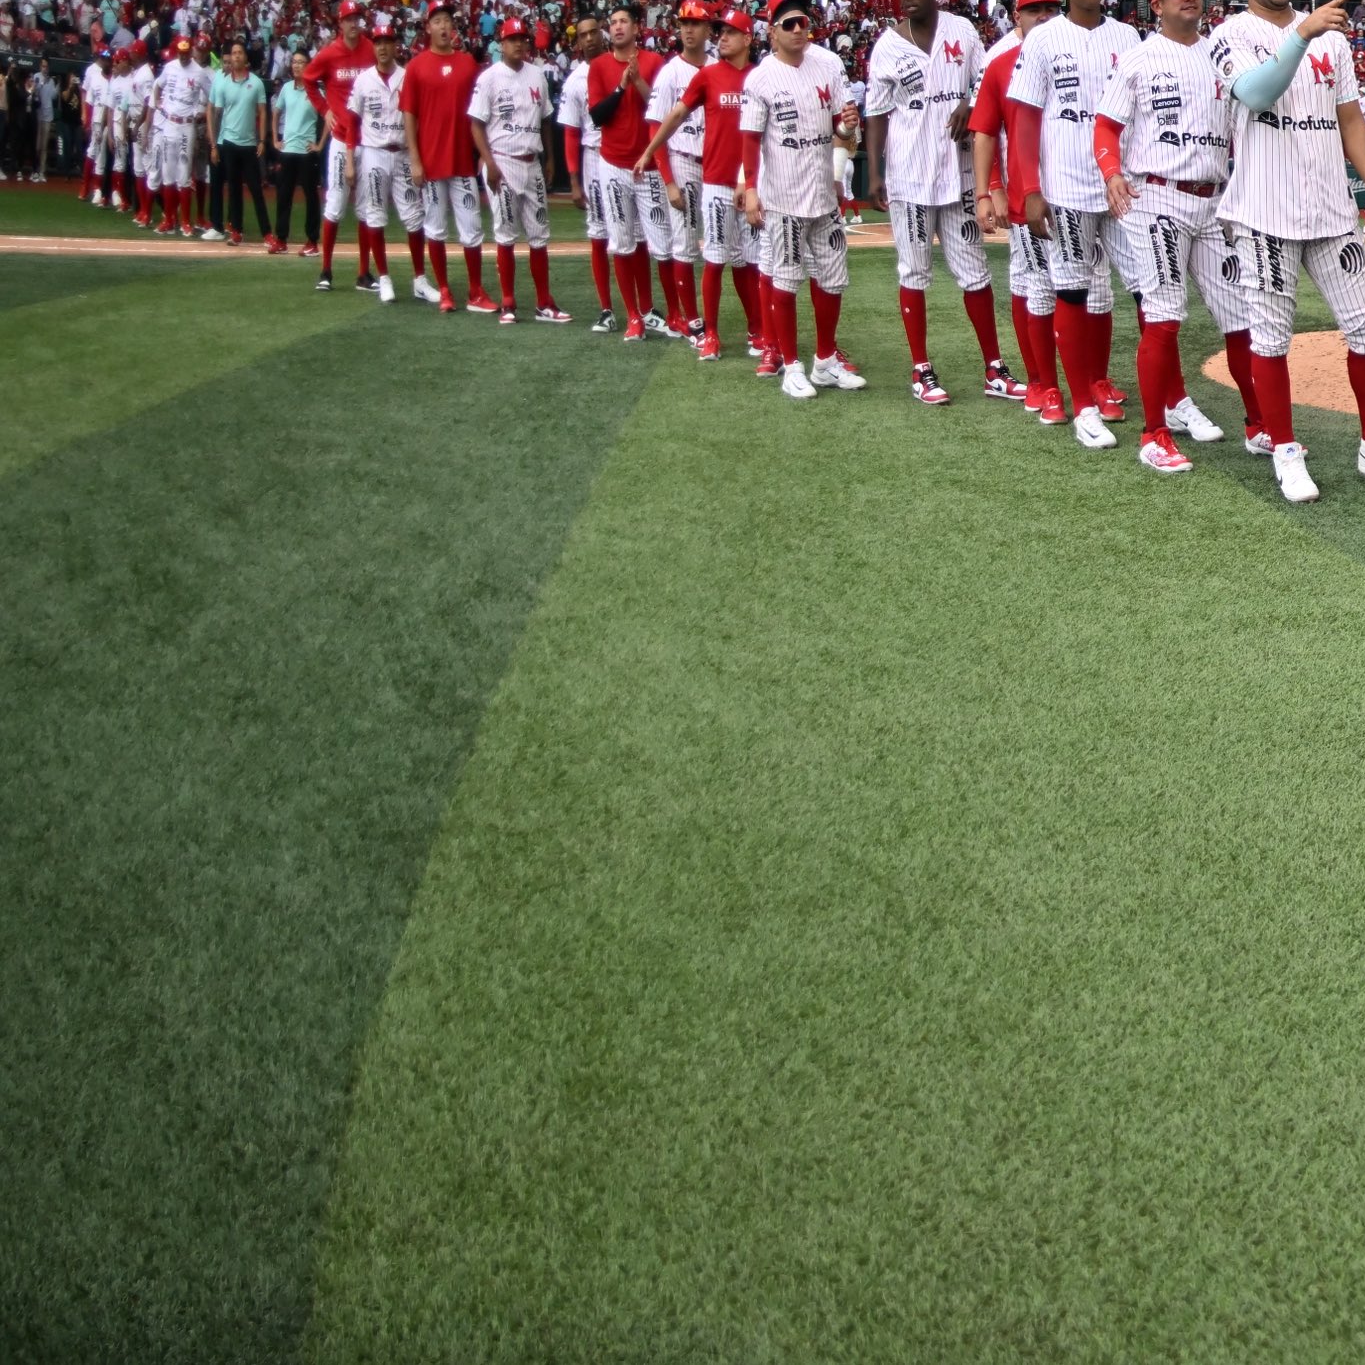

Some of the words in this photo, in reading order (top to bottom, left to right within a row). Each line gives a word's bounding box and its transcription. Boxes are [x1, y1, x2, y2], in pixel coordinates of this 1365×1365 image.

[1053, 64, 1078, 75] Mobil
[1151, 83, 1180, 95] Mobil
[1154, 99, 1180, 108] Lenovo
[1056, 216, 1069, 263] caliente.mx
[1151, 234, 1166, 285] caliente.mx
